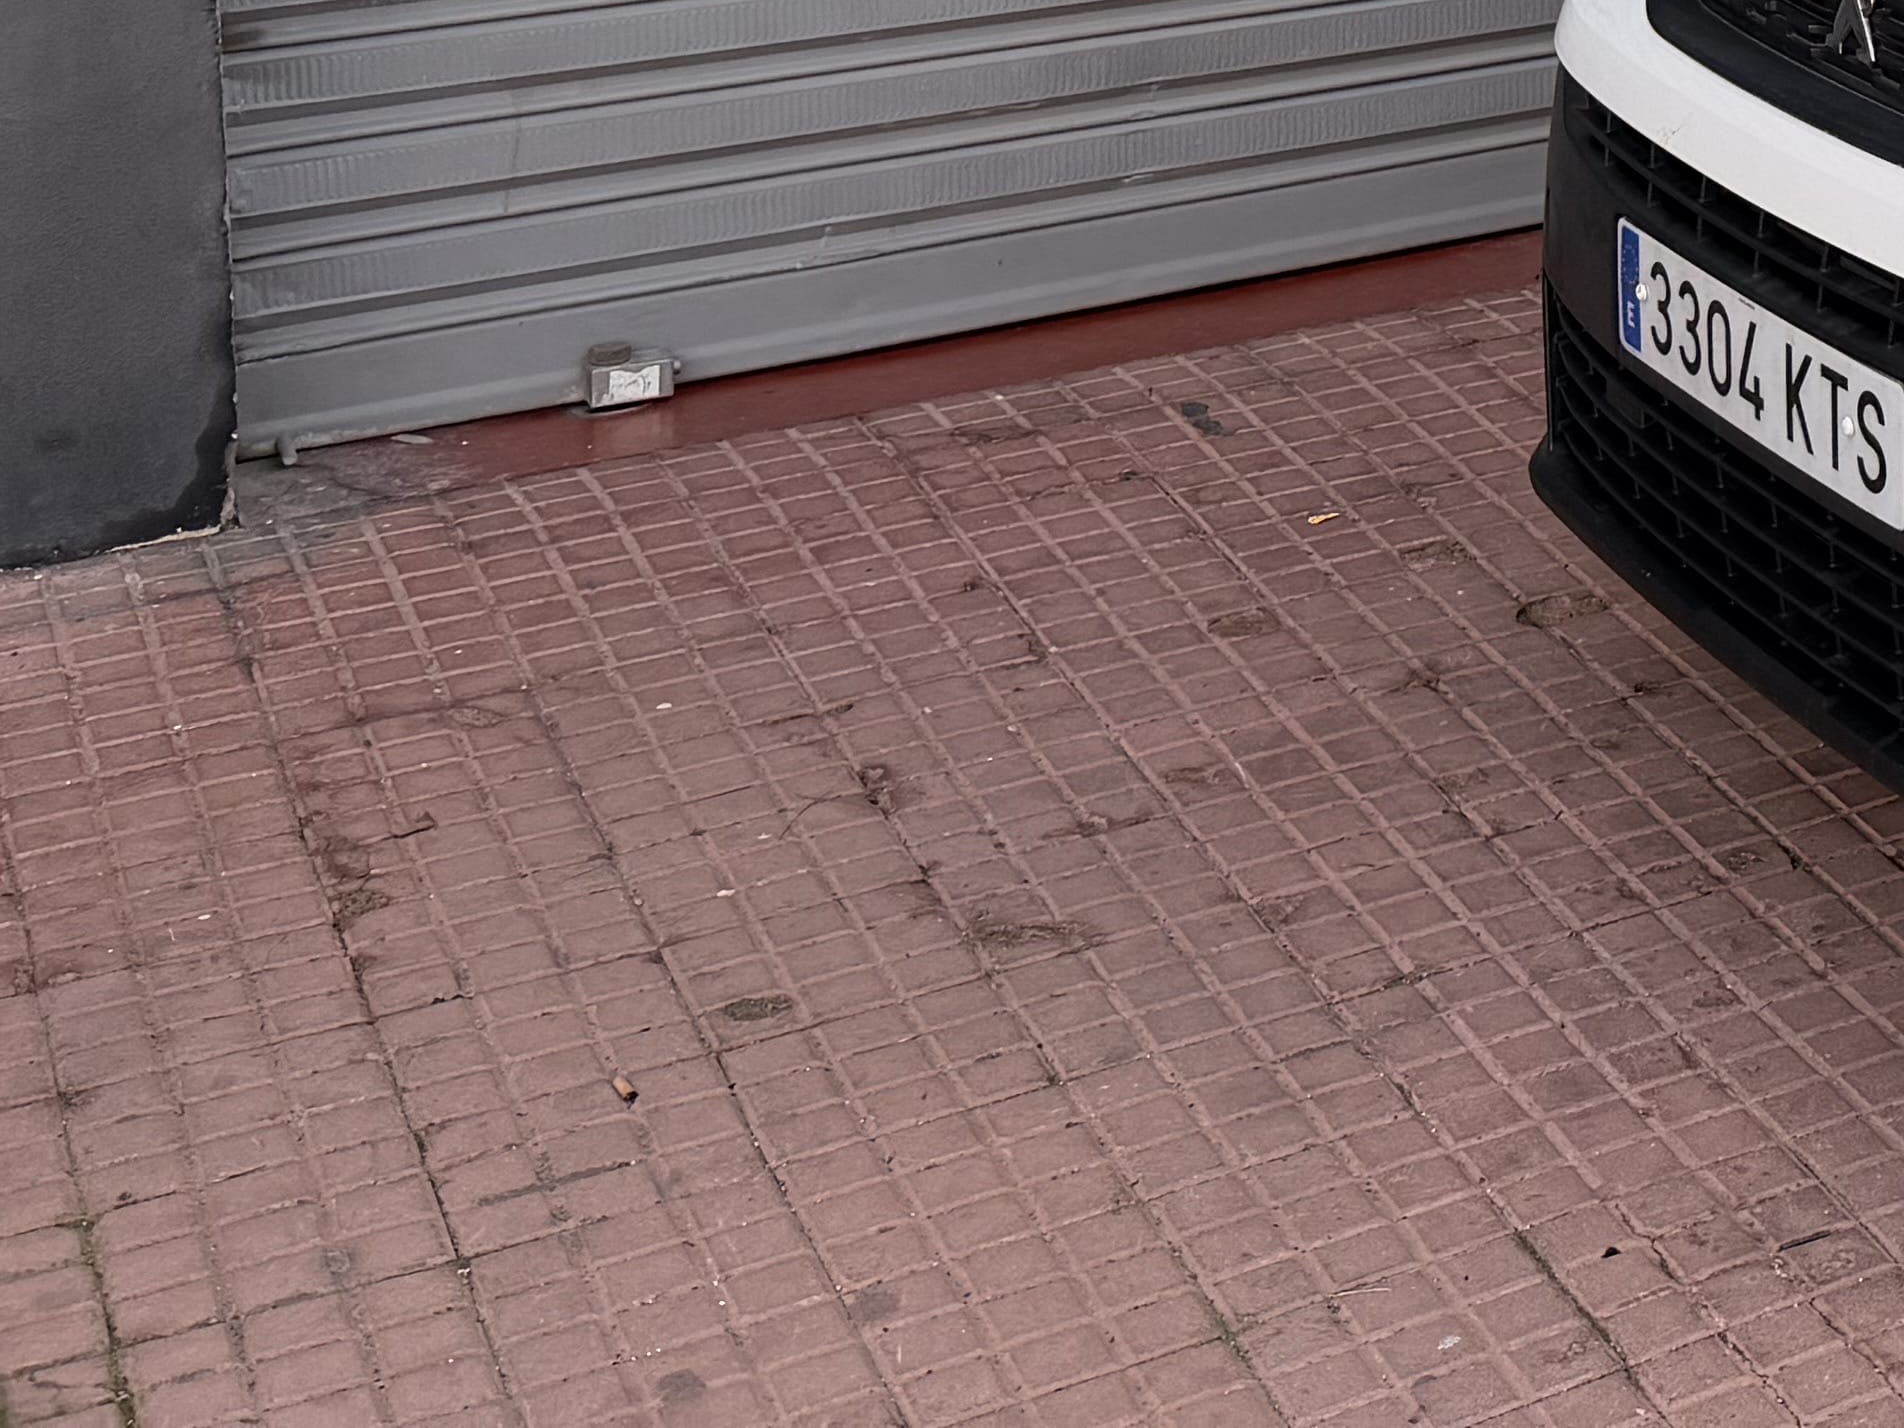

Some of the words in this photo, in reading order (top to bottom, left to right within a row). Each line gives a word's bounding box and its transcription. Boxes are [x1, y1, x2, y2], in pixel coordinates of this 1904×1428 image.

[1626, 300, 1636, 328] E
[1651, 261, 1764, 421] 3304
[1785, 342, 1888, 495] KTS
